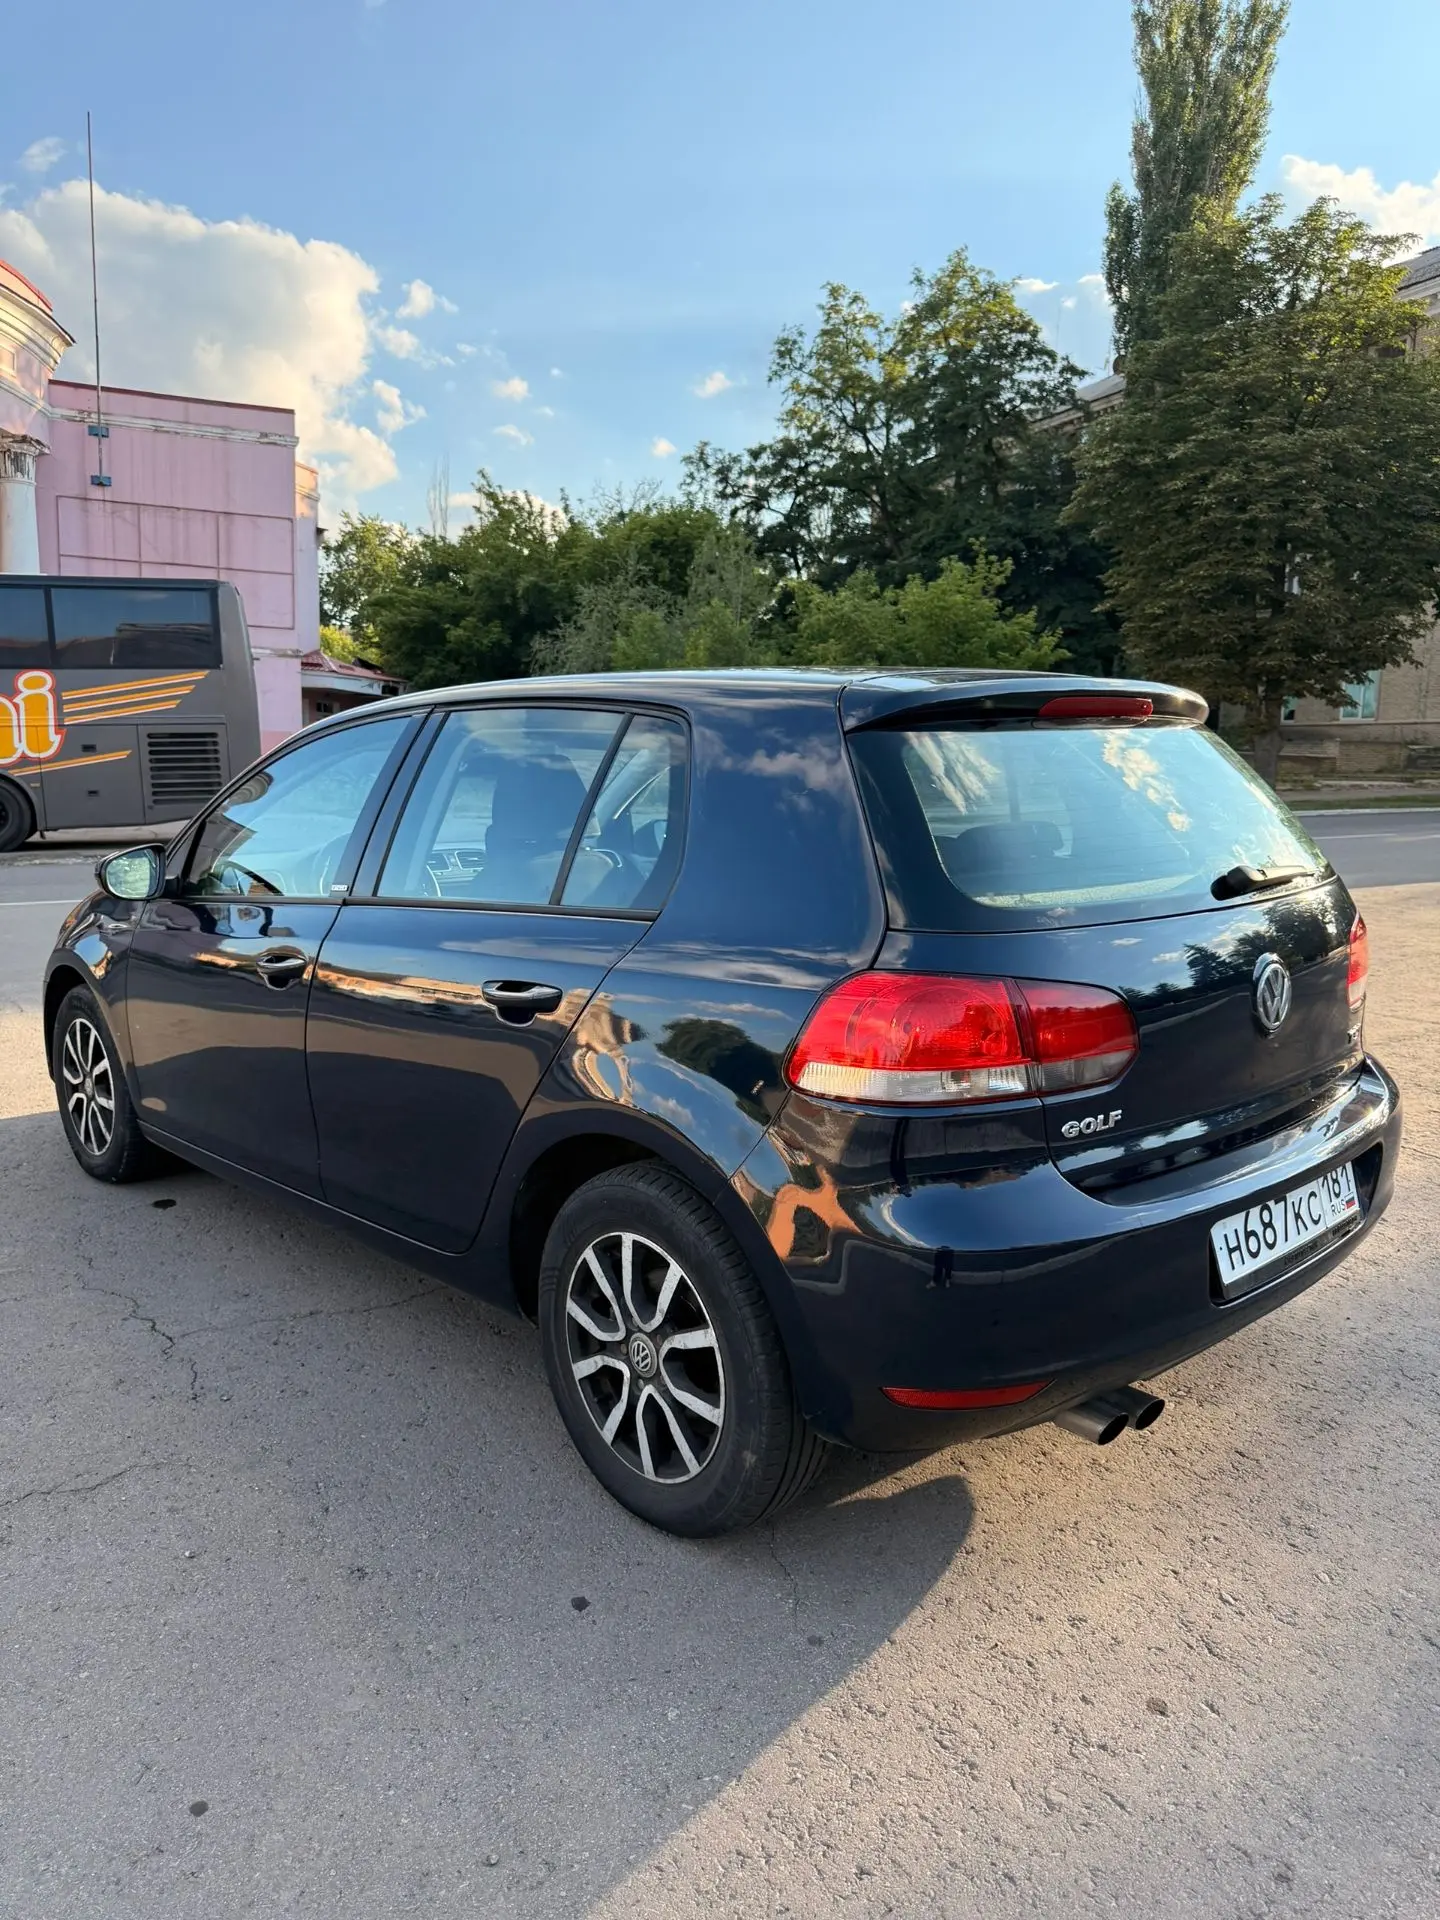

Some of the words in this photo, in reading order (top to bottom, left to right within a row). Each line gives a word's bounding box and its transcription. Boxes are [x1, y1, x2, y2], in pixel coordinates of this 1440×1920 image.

[1061, 1109, 1122, 1138] GOLF
[1321, 1167, 1352, 1203] 181
[1331, 1199, 1346, 1217] RUS
